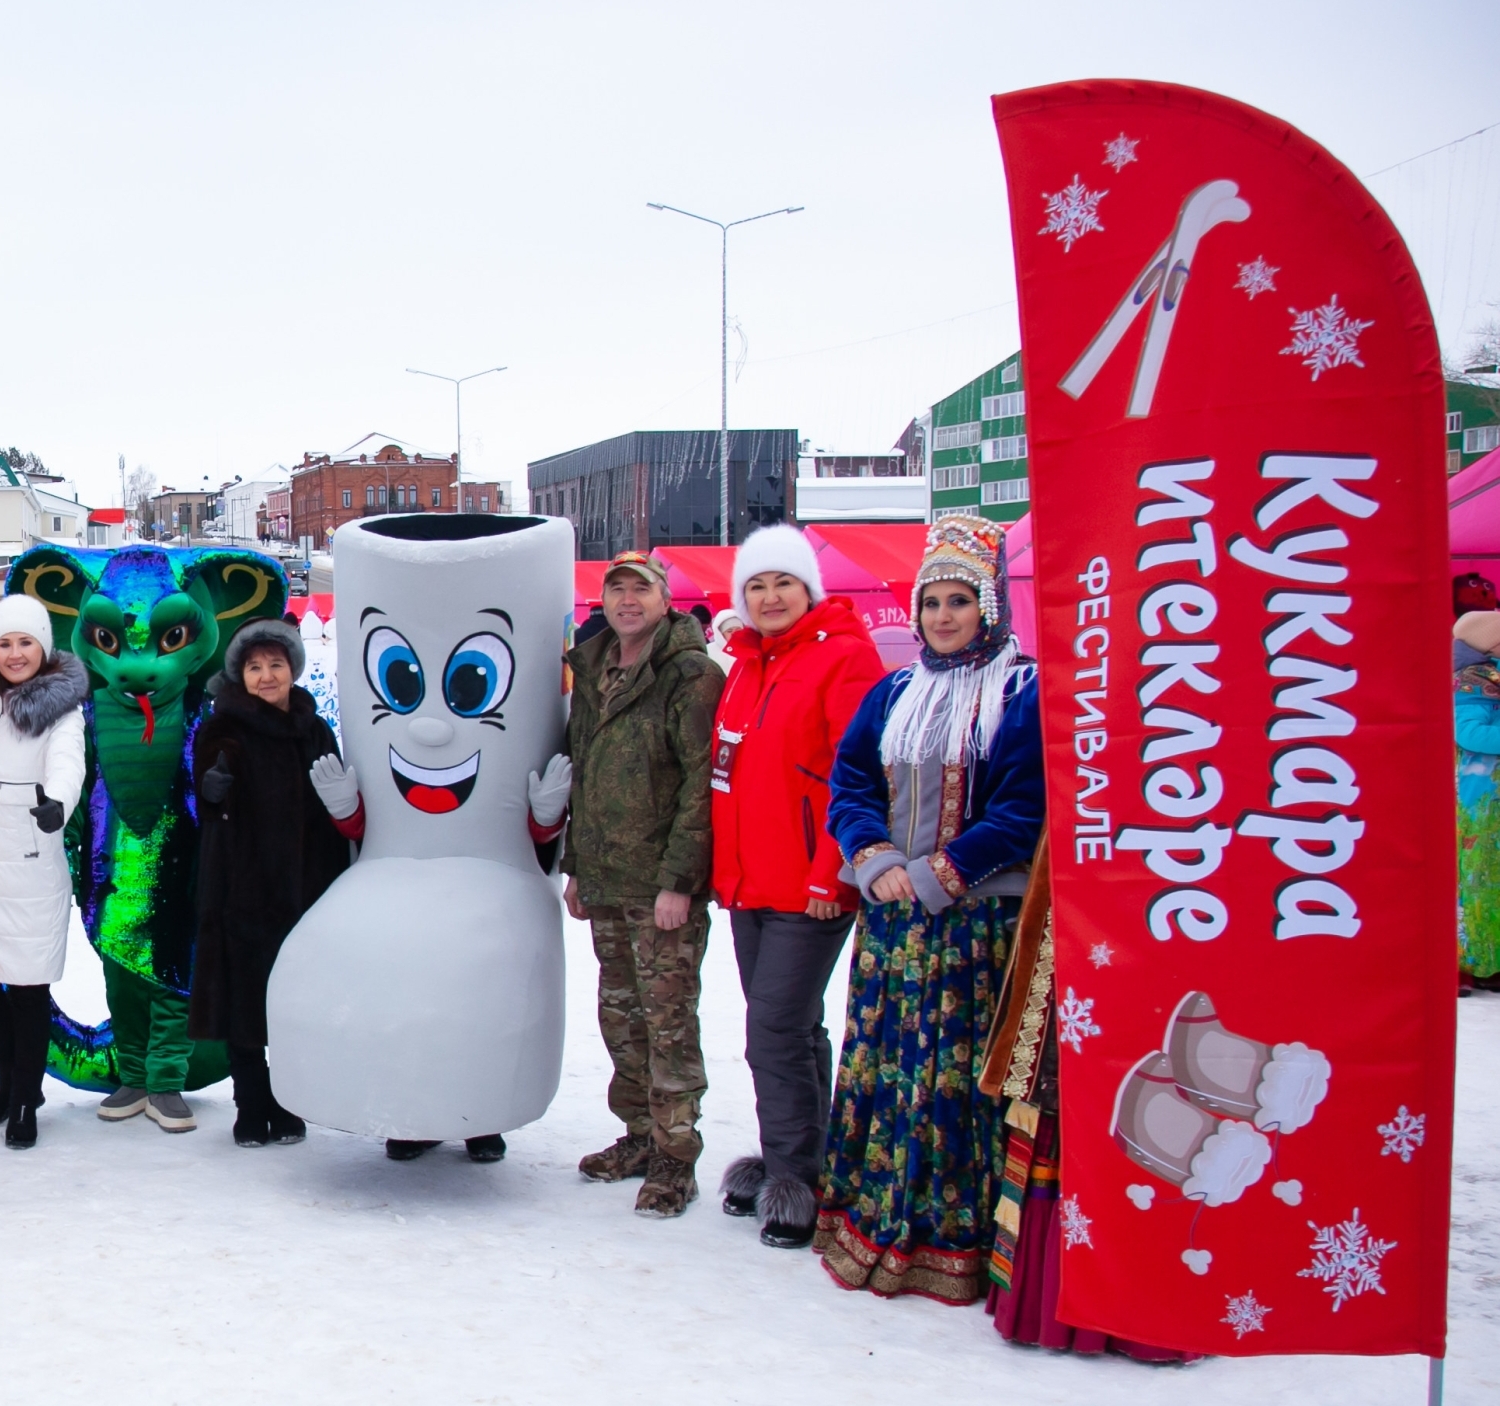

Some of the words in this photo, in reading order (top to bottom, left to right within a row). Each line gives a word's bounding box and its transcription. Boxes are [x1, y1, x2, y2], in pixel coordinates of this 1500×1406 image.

[1074, 556, 1112, 864] ФЕСТИВАЛЕ
[1115, 460, 1232, 942] итекләре
[1227, 455, 1379, 941] Кукмара
